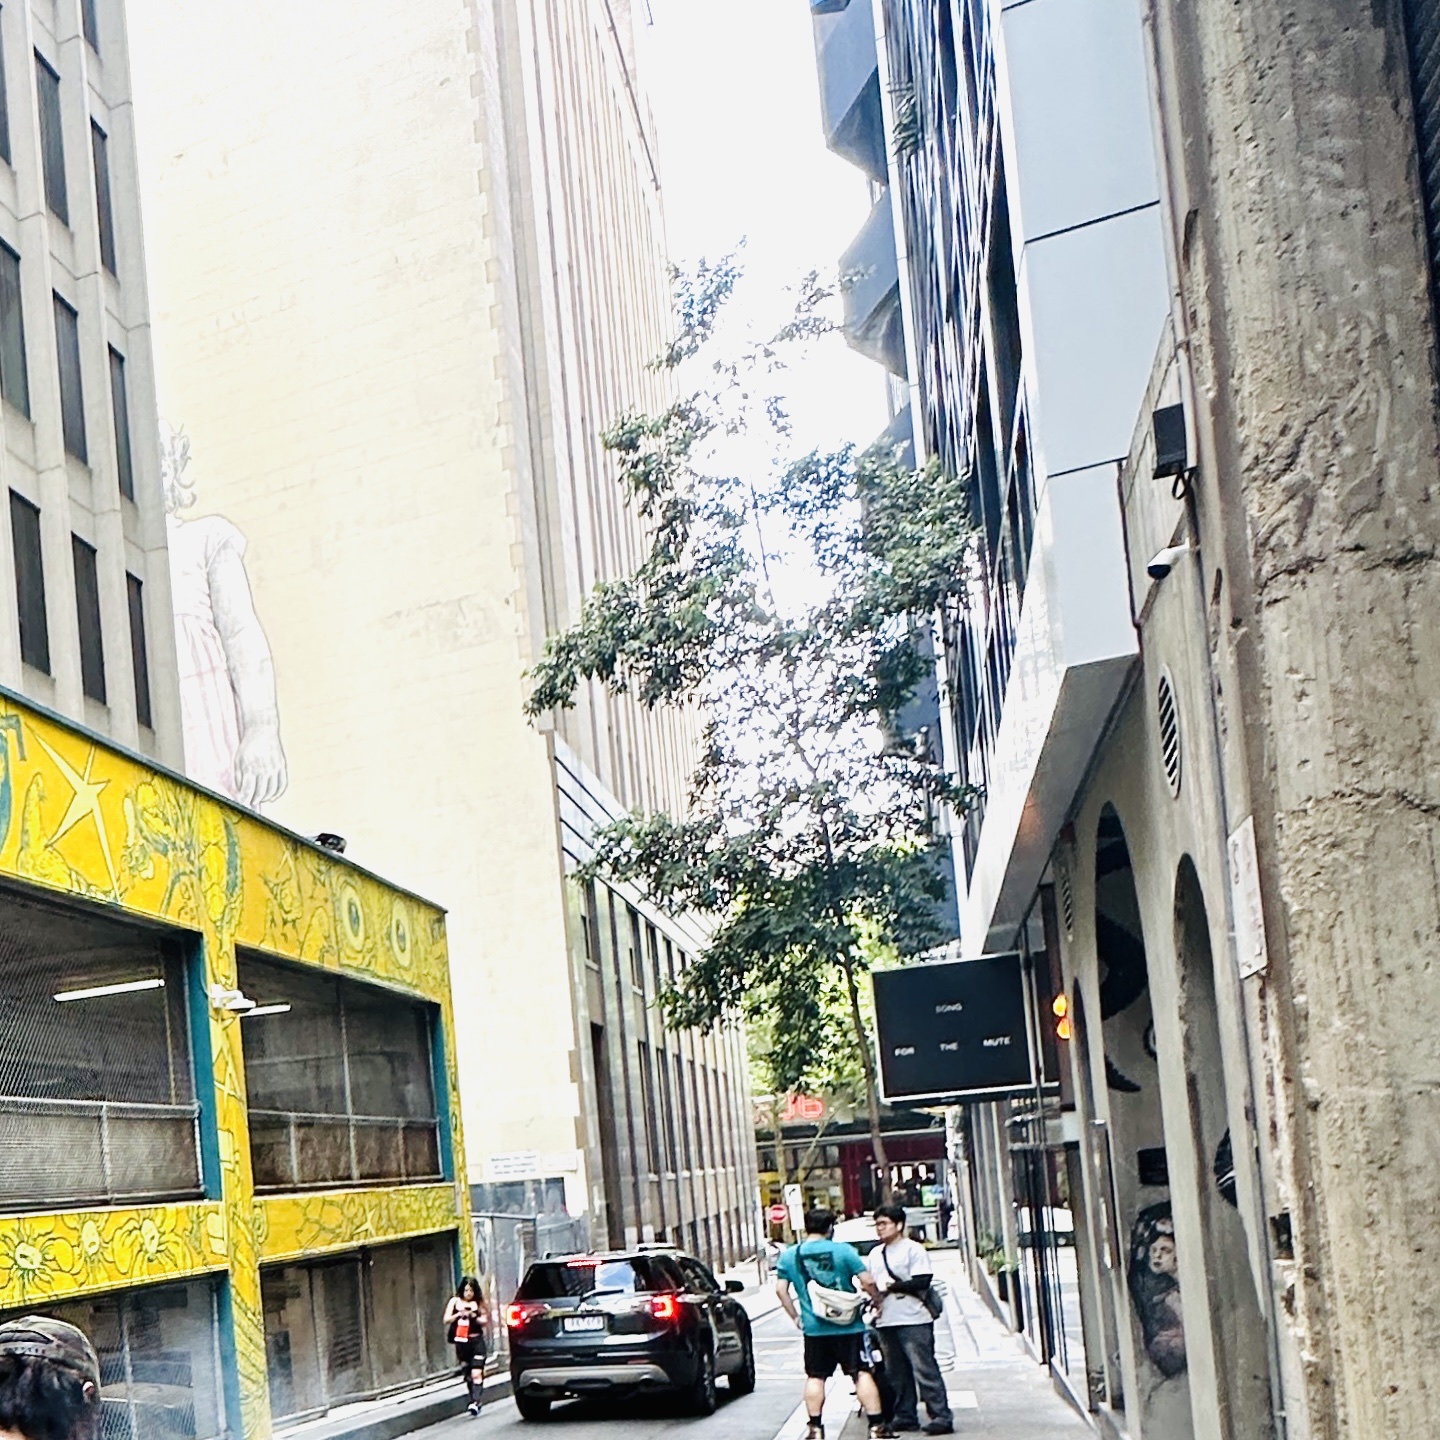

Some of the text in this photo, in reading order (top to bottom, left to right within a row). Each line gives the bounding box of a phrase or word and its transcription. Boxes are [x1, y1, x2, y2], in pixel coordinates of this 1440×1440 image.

[935, 1002, 963, 1014] SONG
[894, 1035, 1012, 1057] FOR THE MUTE
